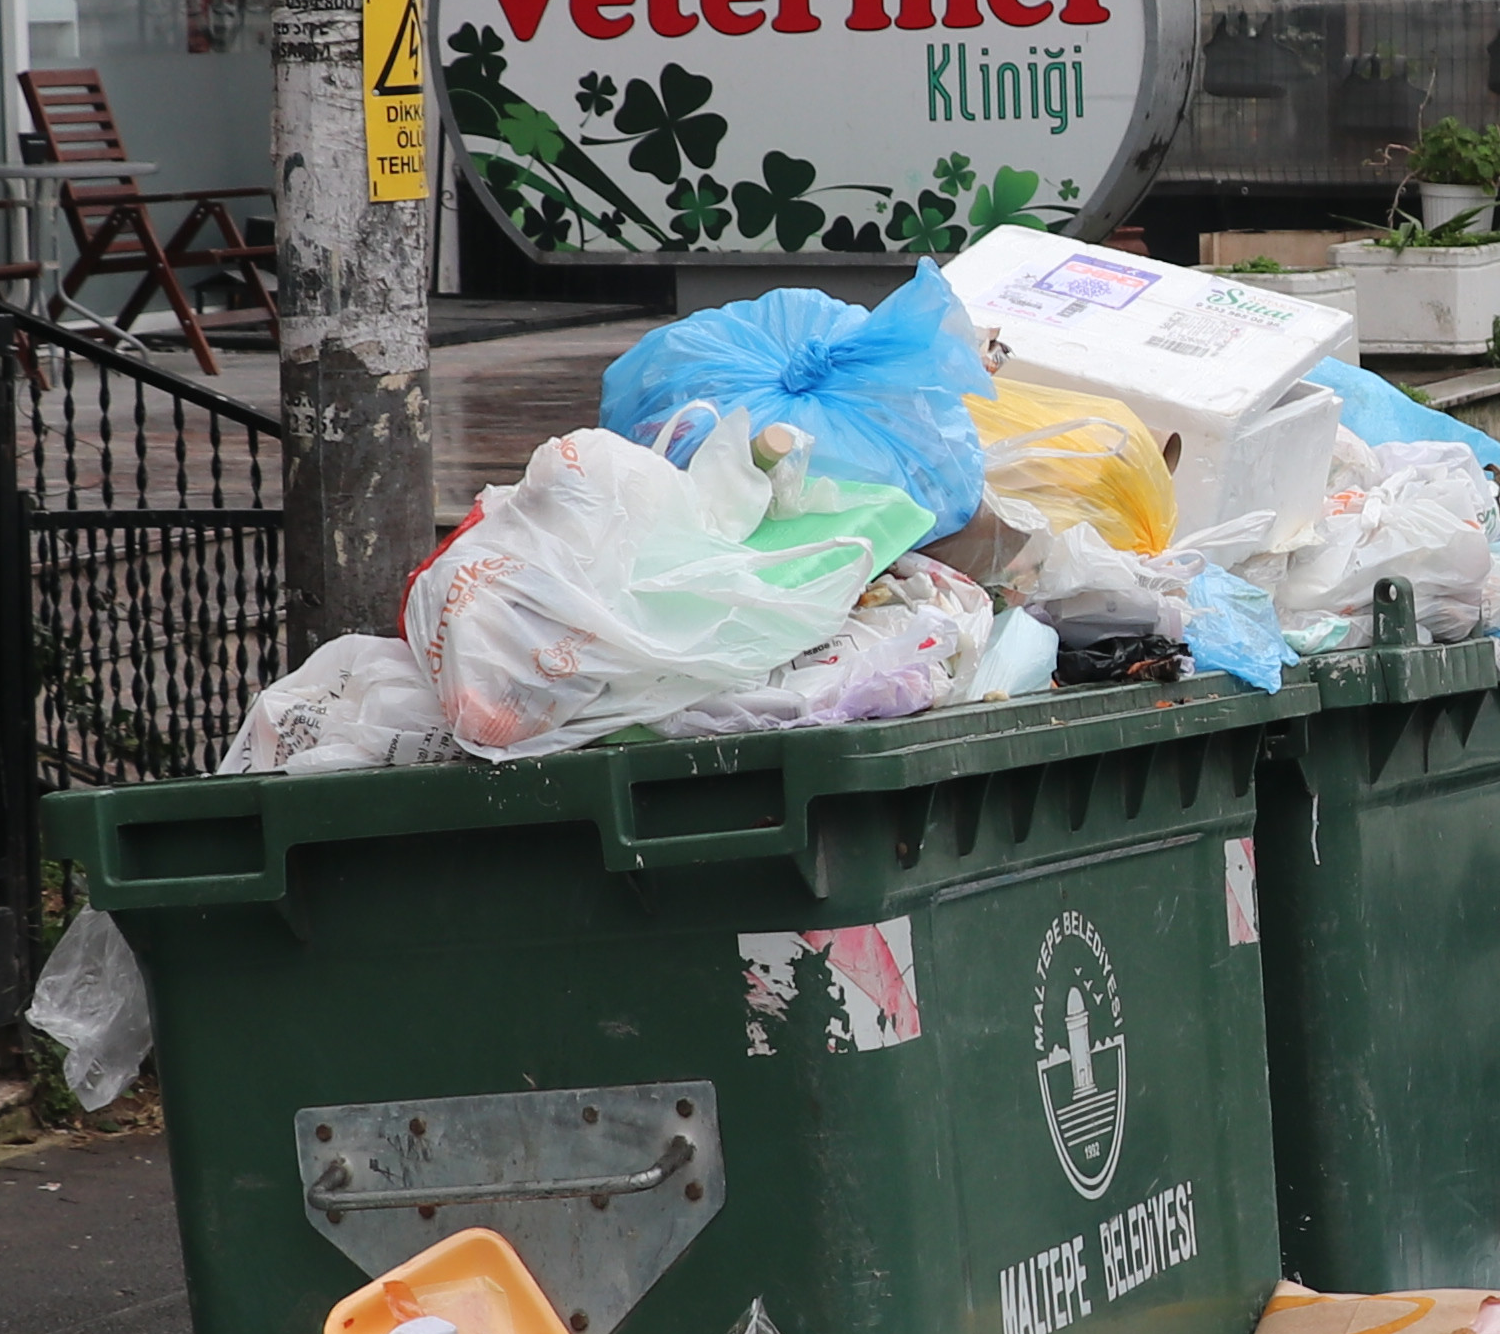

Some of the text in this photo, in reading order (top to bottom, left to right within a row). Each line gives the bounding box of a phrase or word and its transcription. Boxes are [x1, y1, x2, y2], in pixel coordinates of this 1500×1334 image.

[927, 43, 1084, 134] Kliniği
[1034, 917, 1063, 1052] MALTEPE
[1100, 1181, 1198, 1303] BELEDİYESİ
